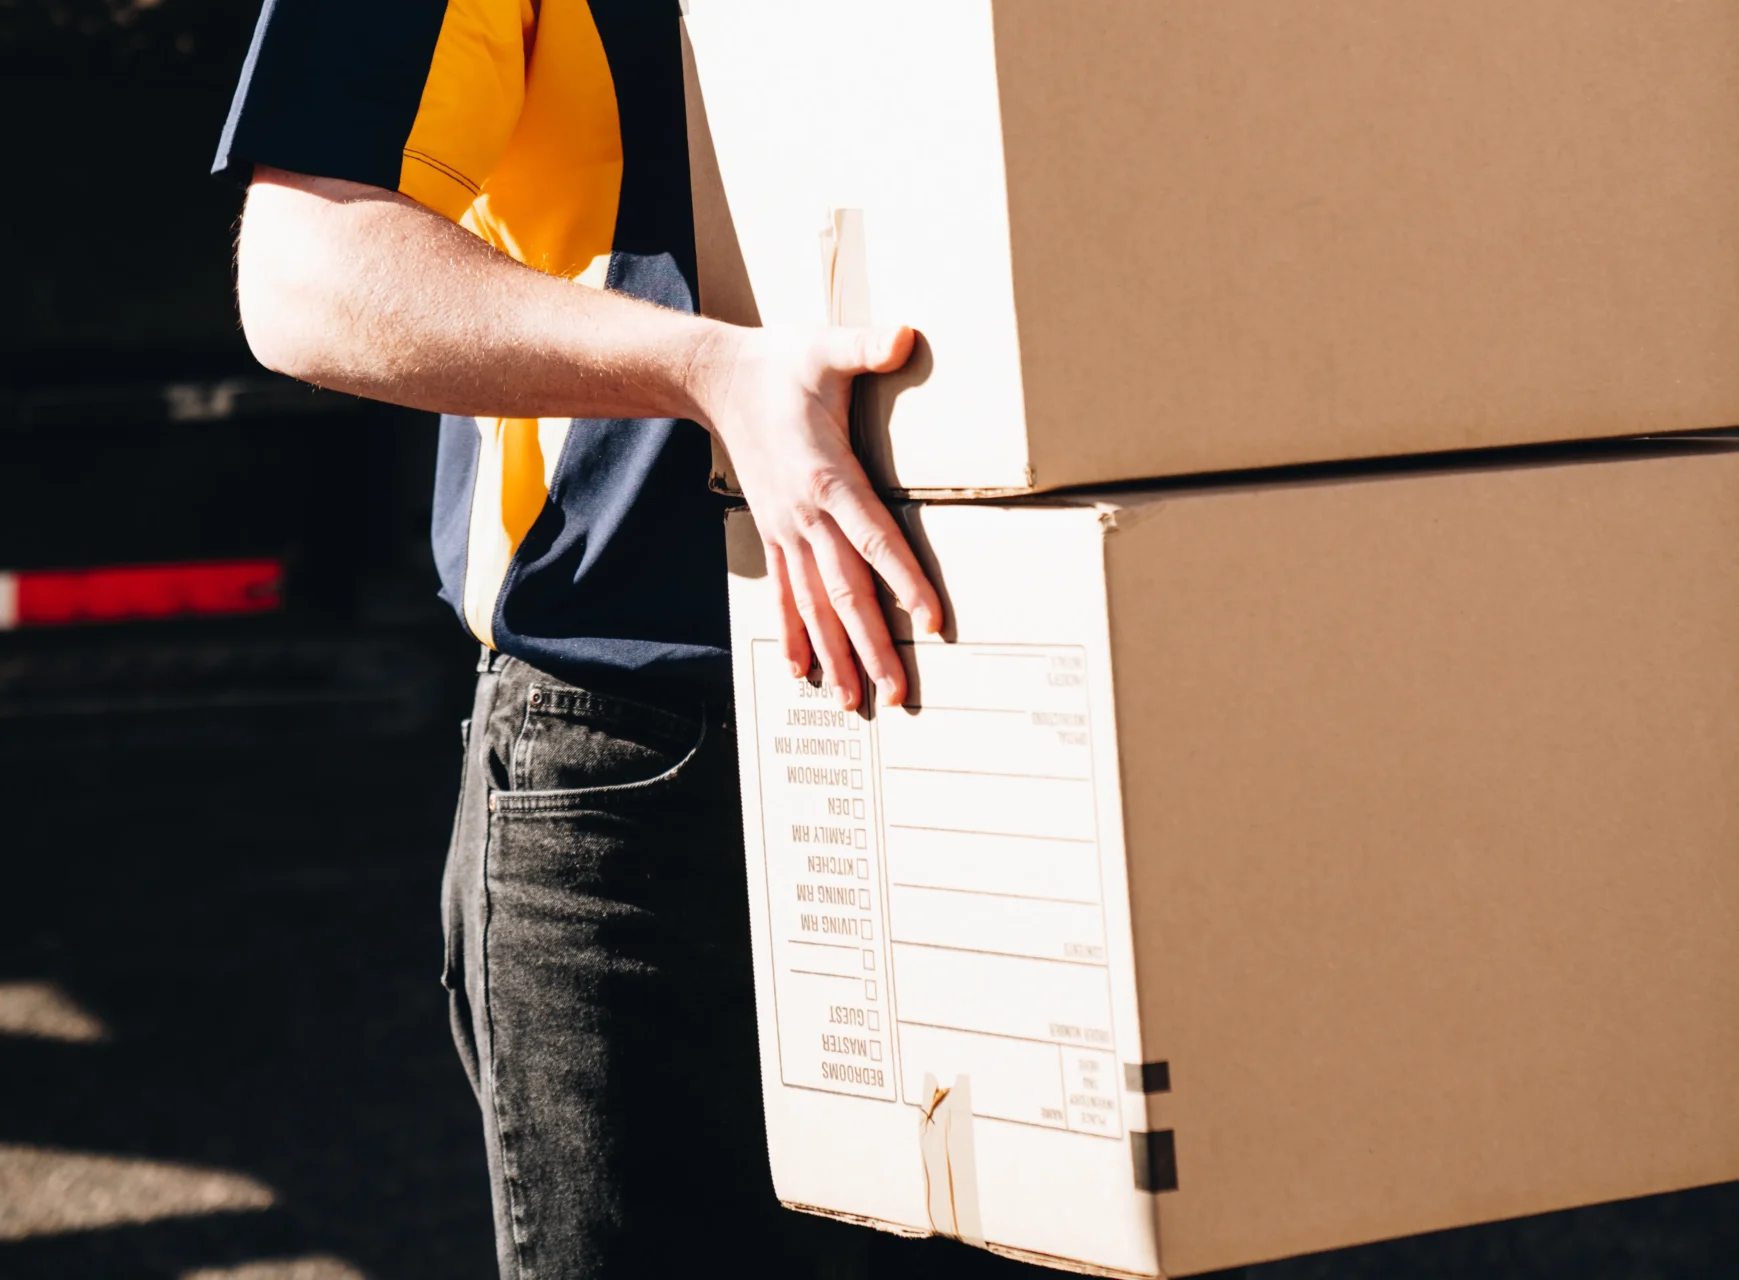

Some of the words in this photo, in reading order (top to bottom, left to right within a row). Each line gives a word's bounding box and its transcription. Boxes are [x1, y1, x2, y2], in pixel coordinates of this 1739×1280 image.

[798, 680, 834, 699] RAGE
[786, 708, 845, 728] BASEMENT
[774, 736, 792, 755] RM
[795, 737, 847, 756] LAUNDRY
[786, 766, 849, 787] BATHROOM
[827, 797, 850, 816] DEN
[791, 824, 810, 843] RM
[813, 825, 852, 846] FAMILY
[807, 855, 854, 876] KITCHEN
[796, 884, 815, 902] RM
[818, 885, 856, 906] DINING
[800, 913, 819, 932] RM
[822, 915, 859, 936] LIVING
[829, 1005, 865, 1027] GUEST
[821, 1033, 868, 1057] MASTER
[821, 1061, 885, 1088] BEDROOMS
